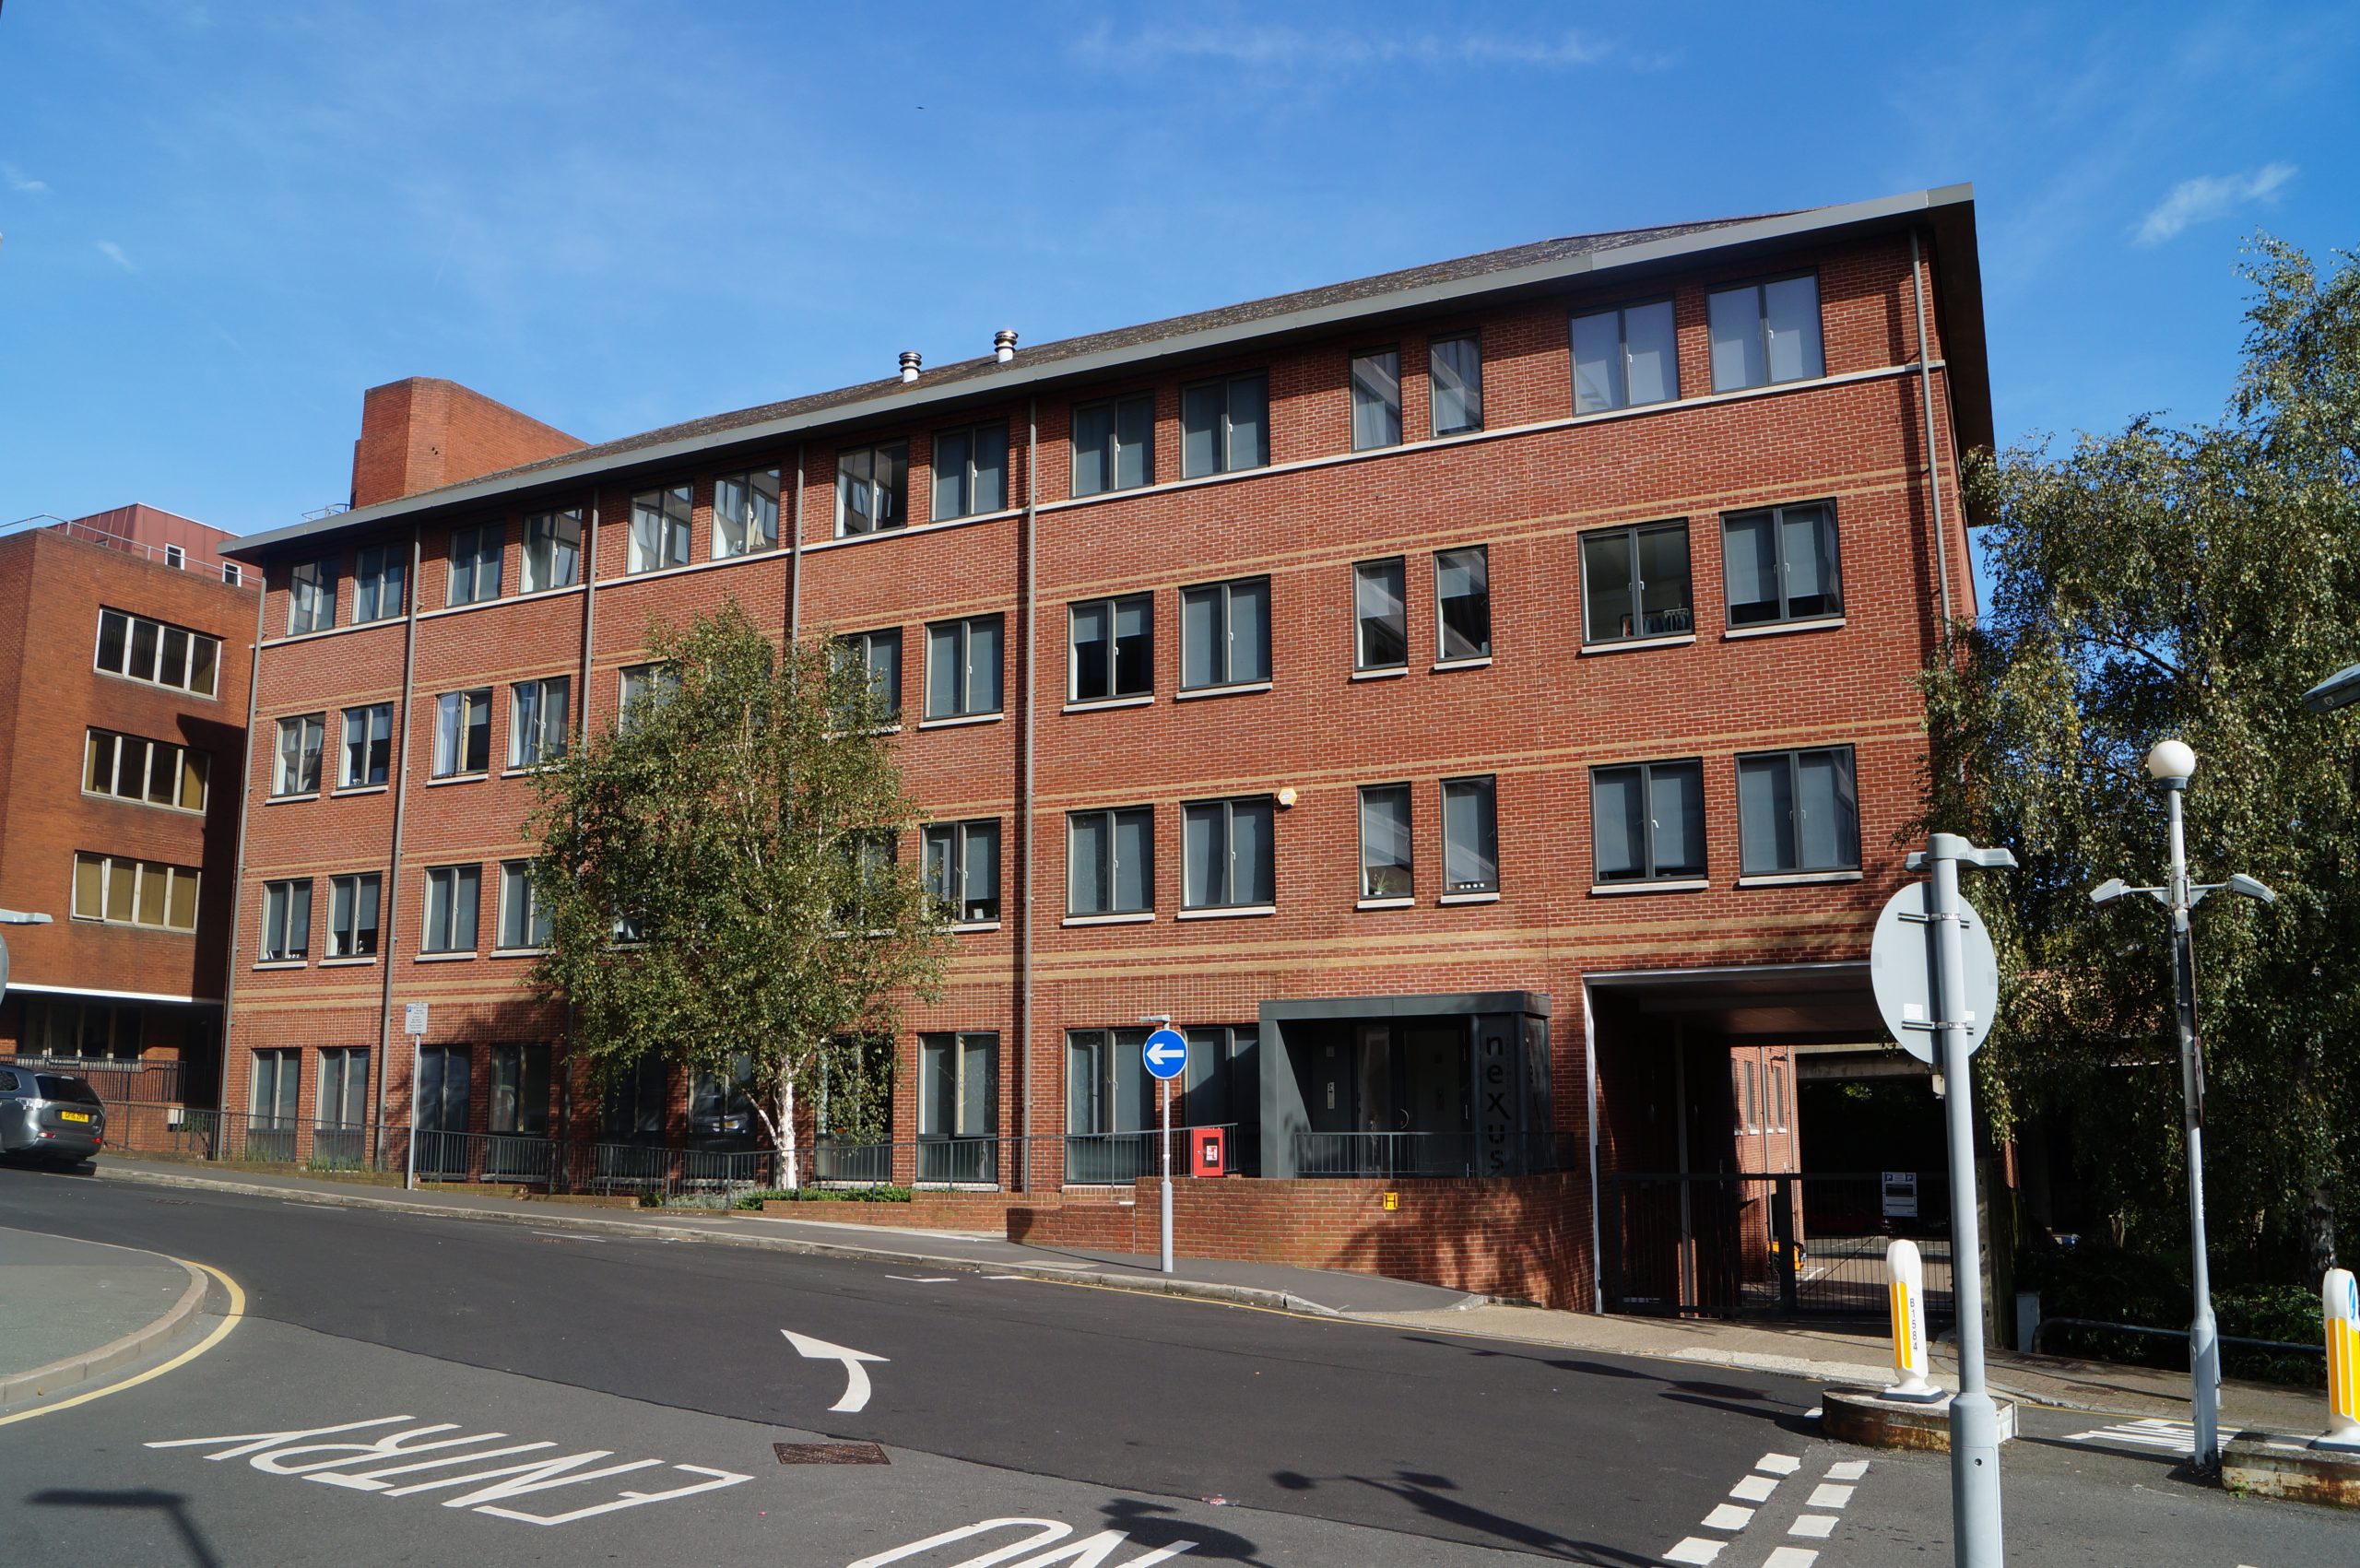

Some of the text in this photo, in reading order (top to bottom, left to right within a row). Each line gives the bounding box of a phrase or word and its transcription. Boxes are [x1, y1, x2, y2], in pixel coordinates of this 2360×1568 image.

[1386, 1195, 1396, 1208] H
[1909, 1298, 1918, 1351] B1584
[142, 1415, 756, 1526] ENTRY
